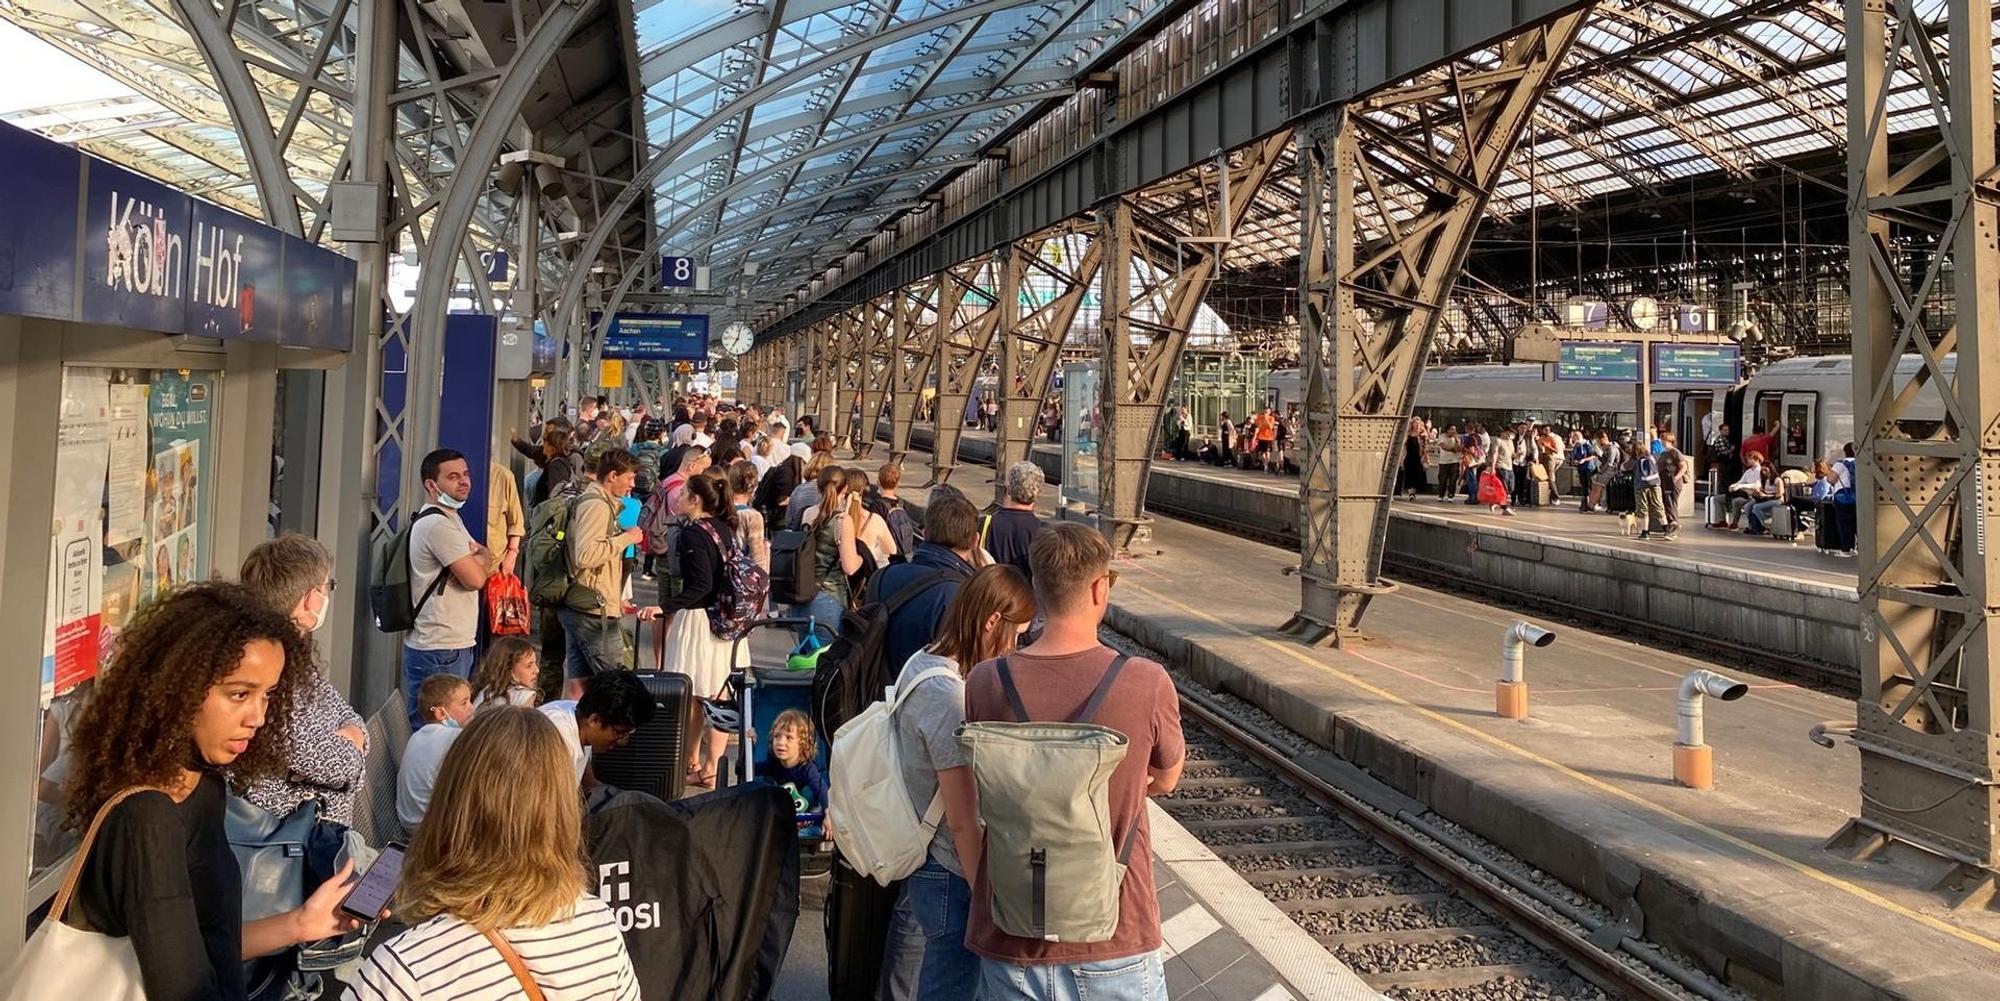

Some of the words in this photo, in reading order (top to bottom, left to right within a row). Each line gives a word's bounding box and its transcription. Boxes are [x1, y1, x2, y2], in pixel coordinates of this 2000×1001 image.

[107, 191, 182, 299] Köln
[193, 221, 244, 309] Hbf
[674, 258, 690, 281] 8
[1584, 302, 1596, 322] 7
[1689, 306, 1701, 326] 6
[618, 327, 641, 335] Aachen
[609, 901, 661, 933] OSI
